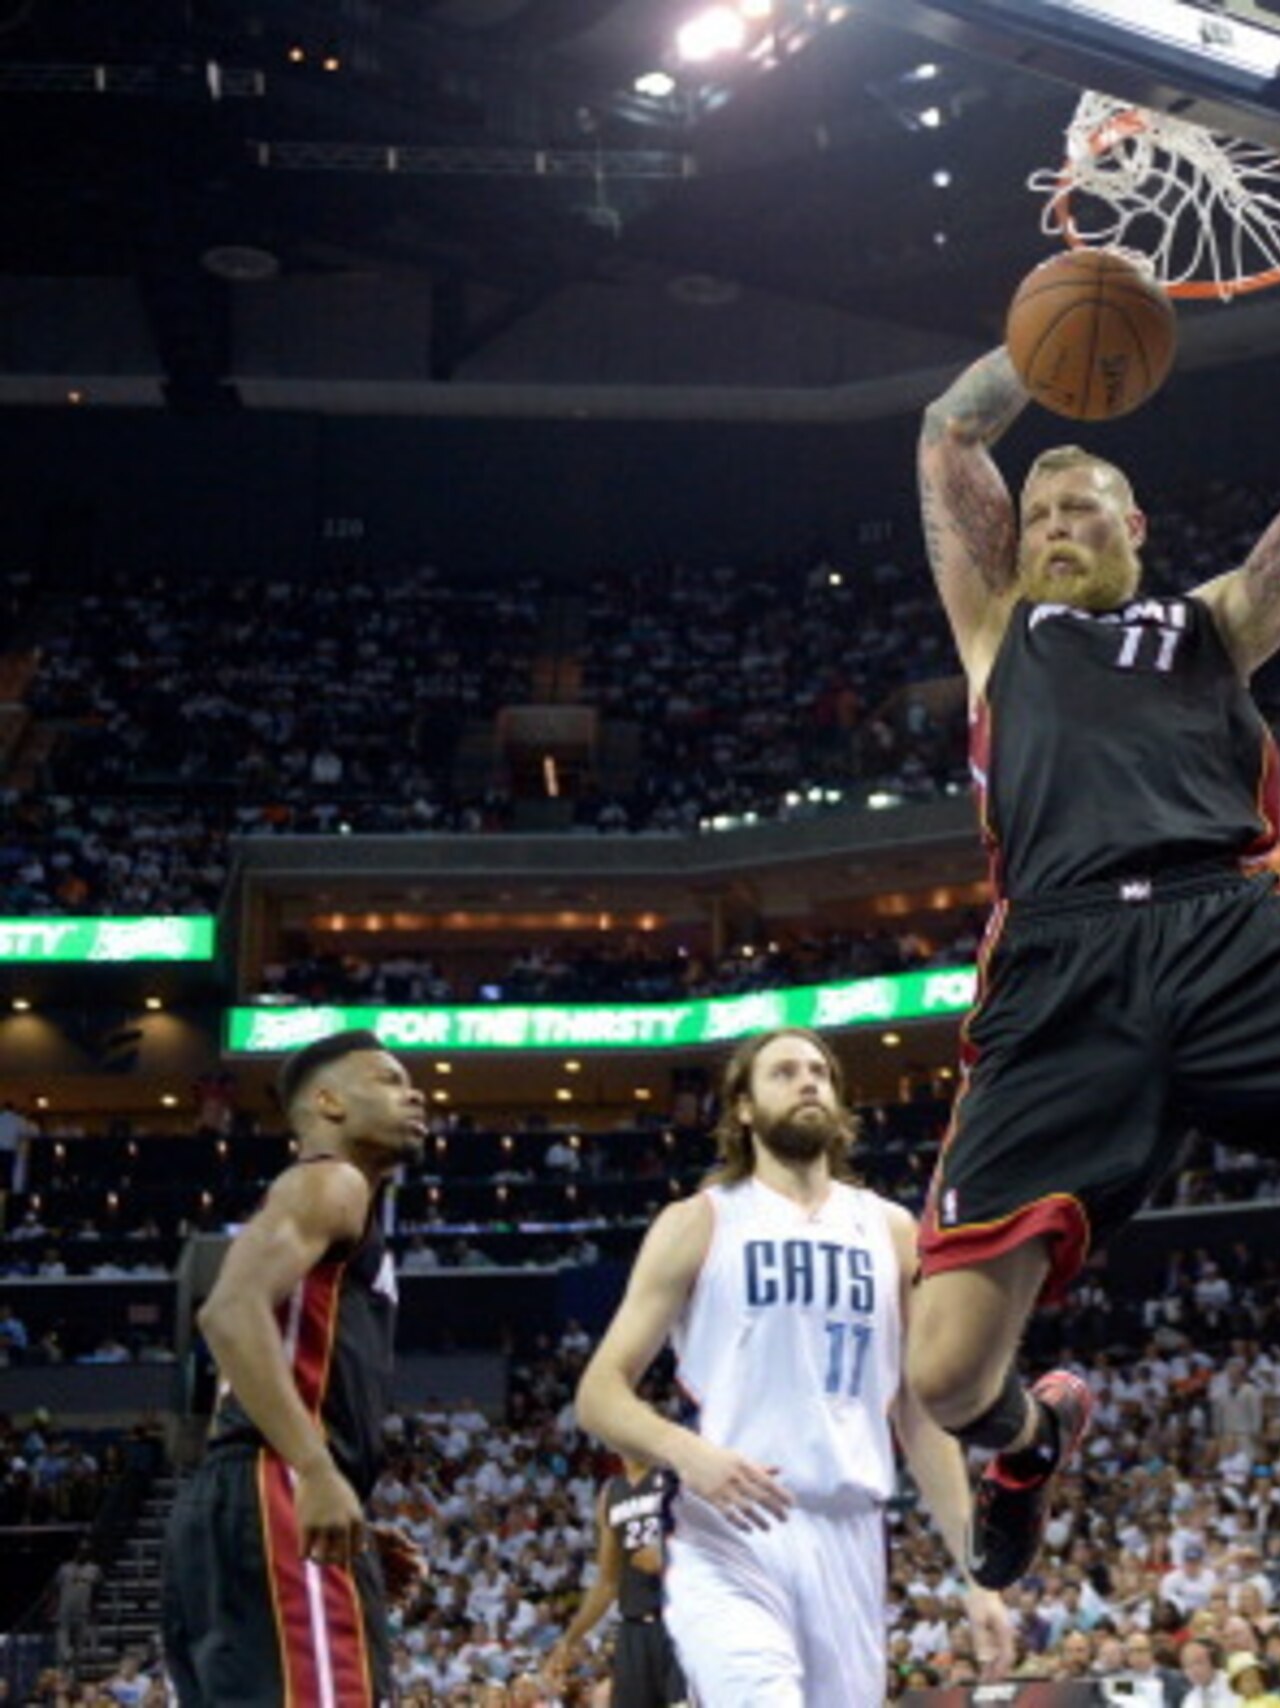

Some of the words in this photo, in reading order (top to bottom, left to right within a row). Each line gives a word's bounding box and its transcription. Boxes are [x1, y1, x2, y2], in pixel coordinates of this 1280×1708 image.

[1117, 626, 1179, 672] 11
[373, 1010, 450, 1043] FOR
[456, 1008, 530, 1044] THE
[529, 1006, 692, 1043] THIRSTY
[743, 1238, 876, 1314] CATS
